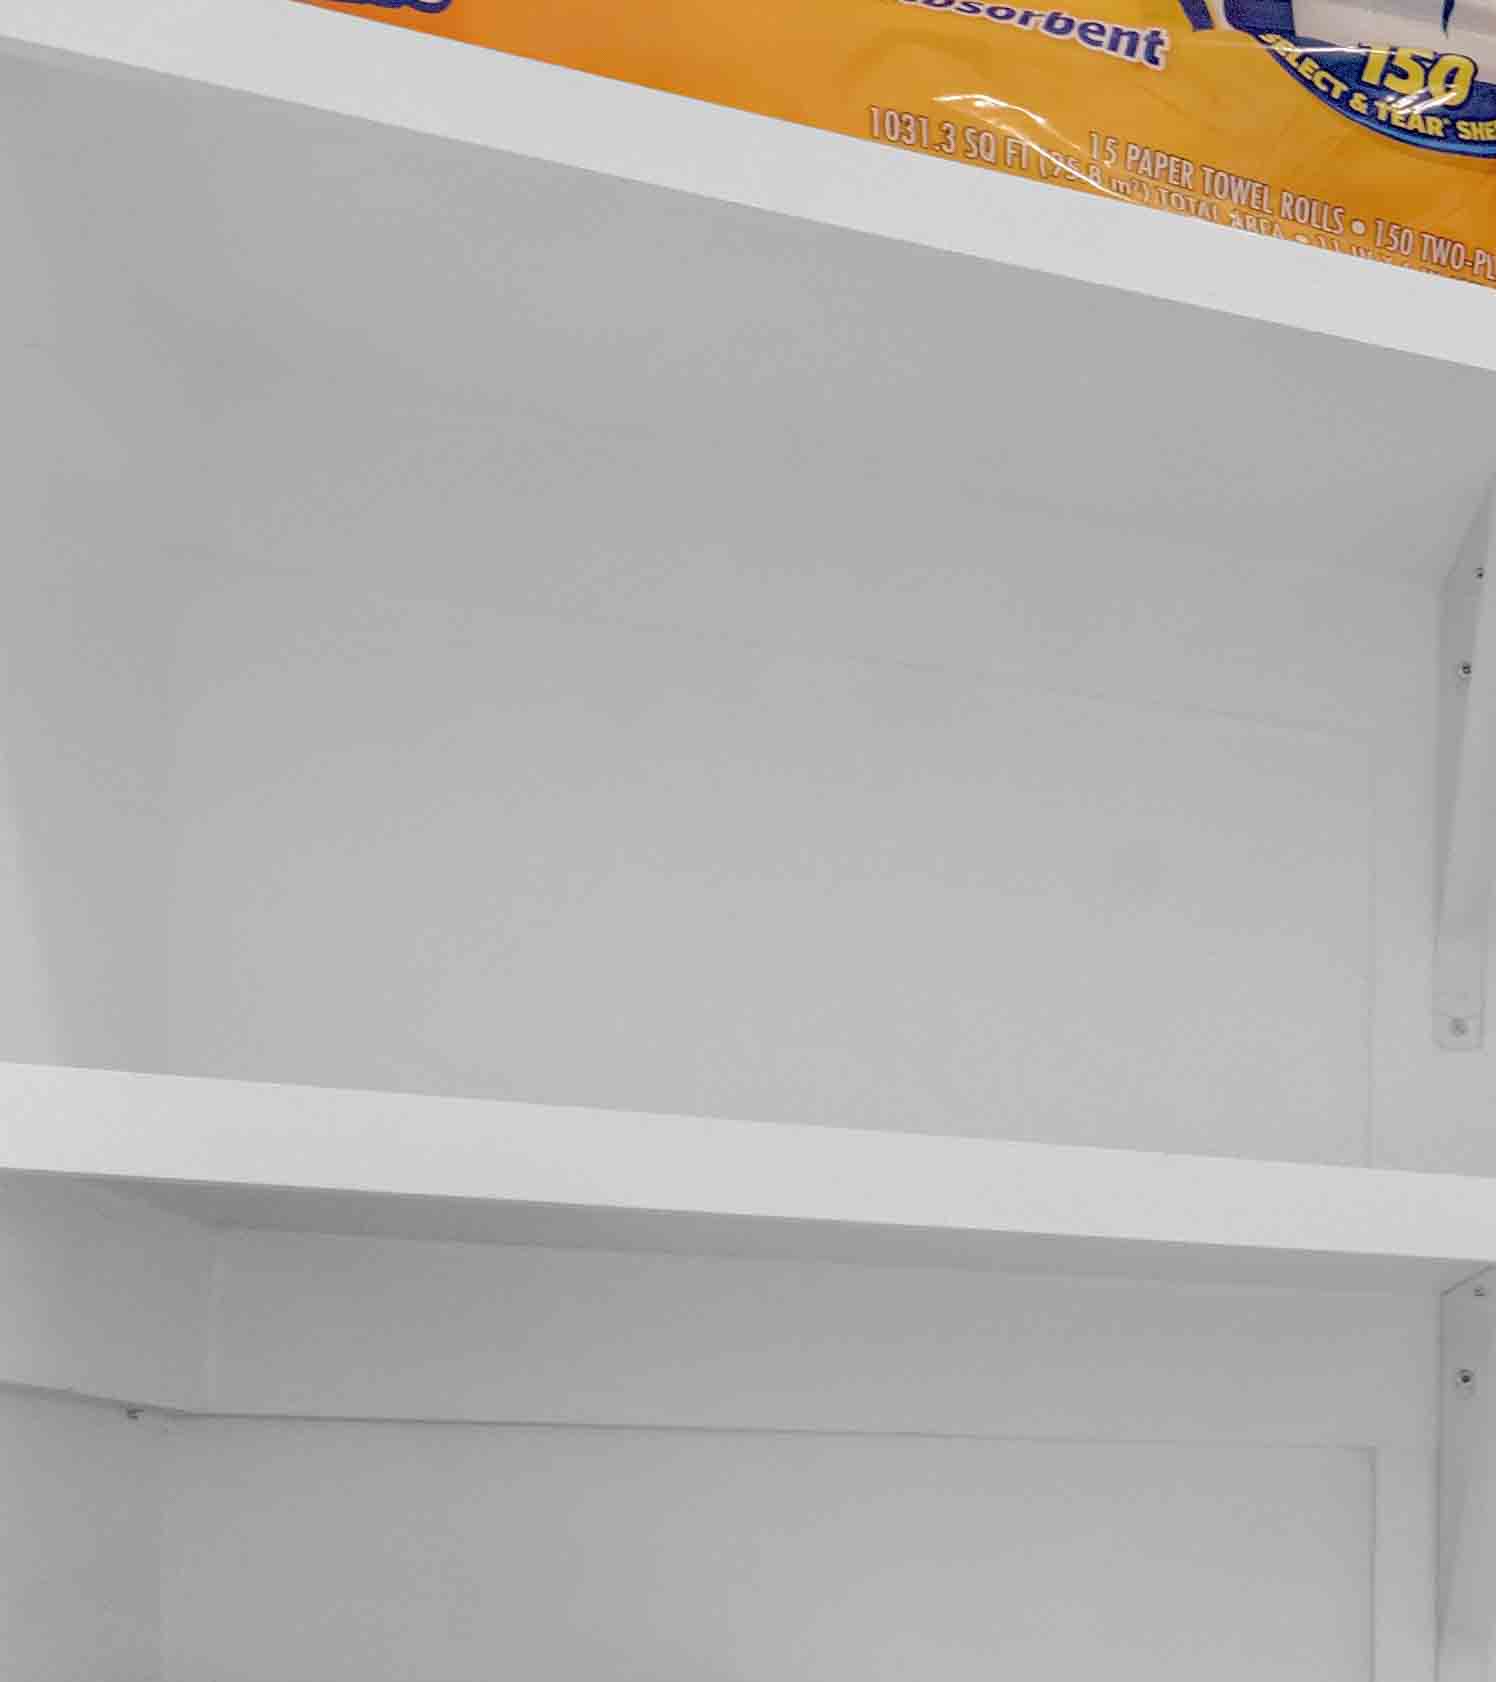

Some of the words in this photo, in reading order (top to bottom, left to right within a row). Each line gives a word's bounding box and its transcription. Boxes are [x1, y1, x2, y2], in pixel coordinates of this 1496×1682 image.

[900, 0, 1168, 68] sorbent
[1349, 92, 1367, 115] &
[1360, 42, 1476, 106] 150
[868, 105, 957, 156] 1031.3
[963, 126, 996, 166] SQ
[1004, 138, 1032, 170] FT
[1090, 131, 1118, 169] 15
[1126, 143, 1194, 190] PAPER
[1200, 165, 1274, 215] TOWEL
[1280, 190, 1345, 236] ROLLS
[1374, 218, 1413, 256] 150
